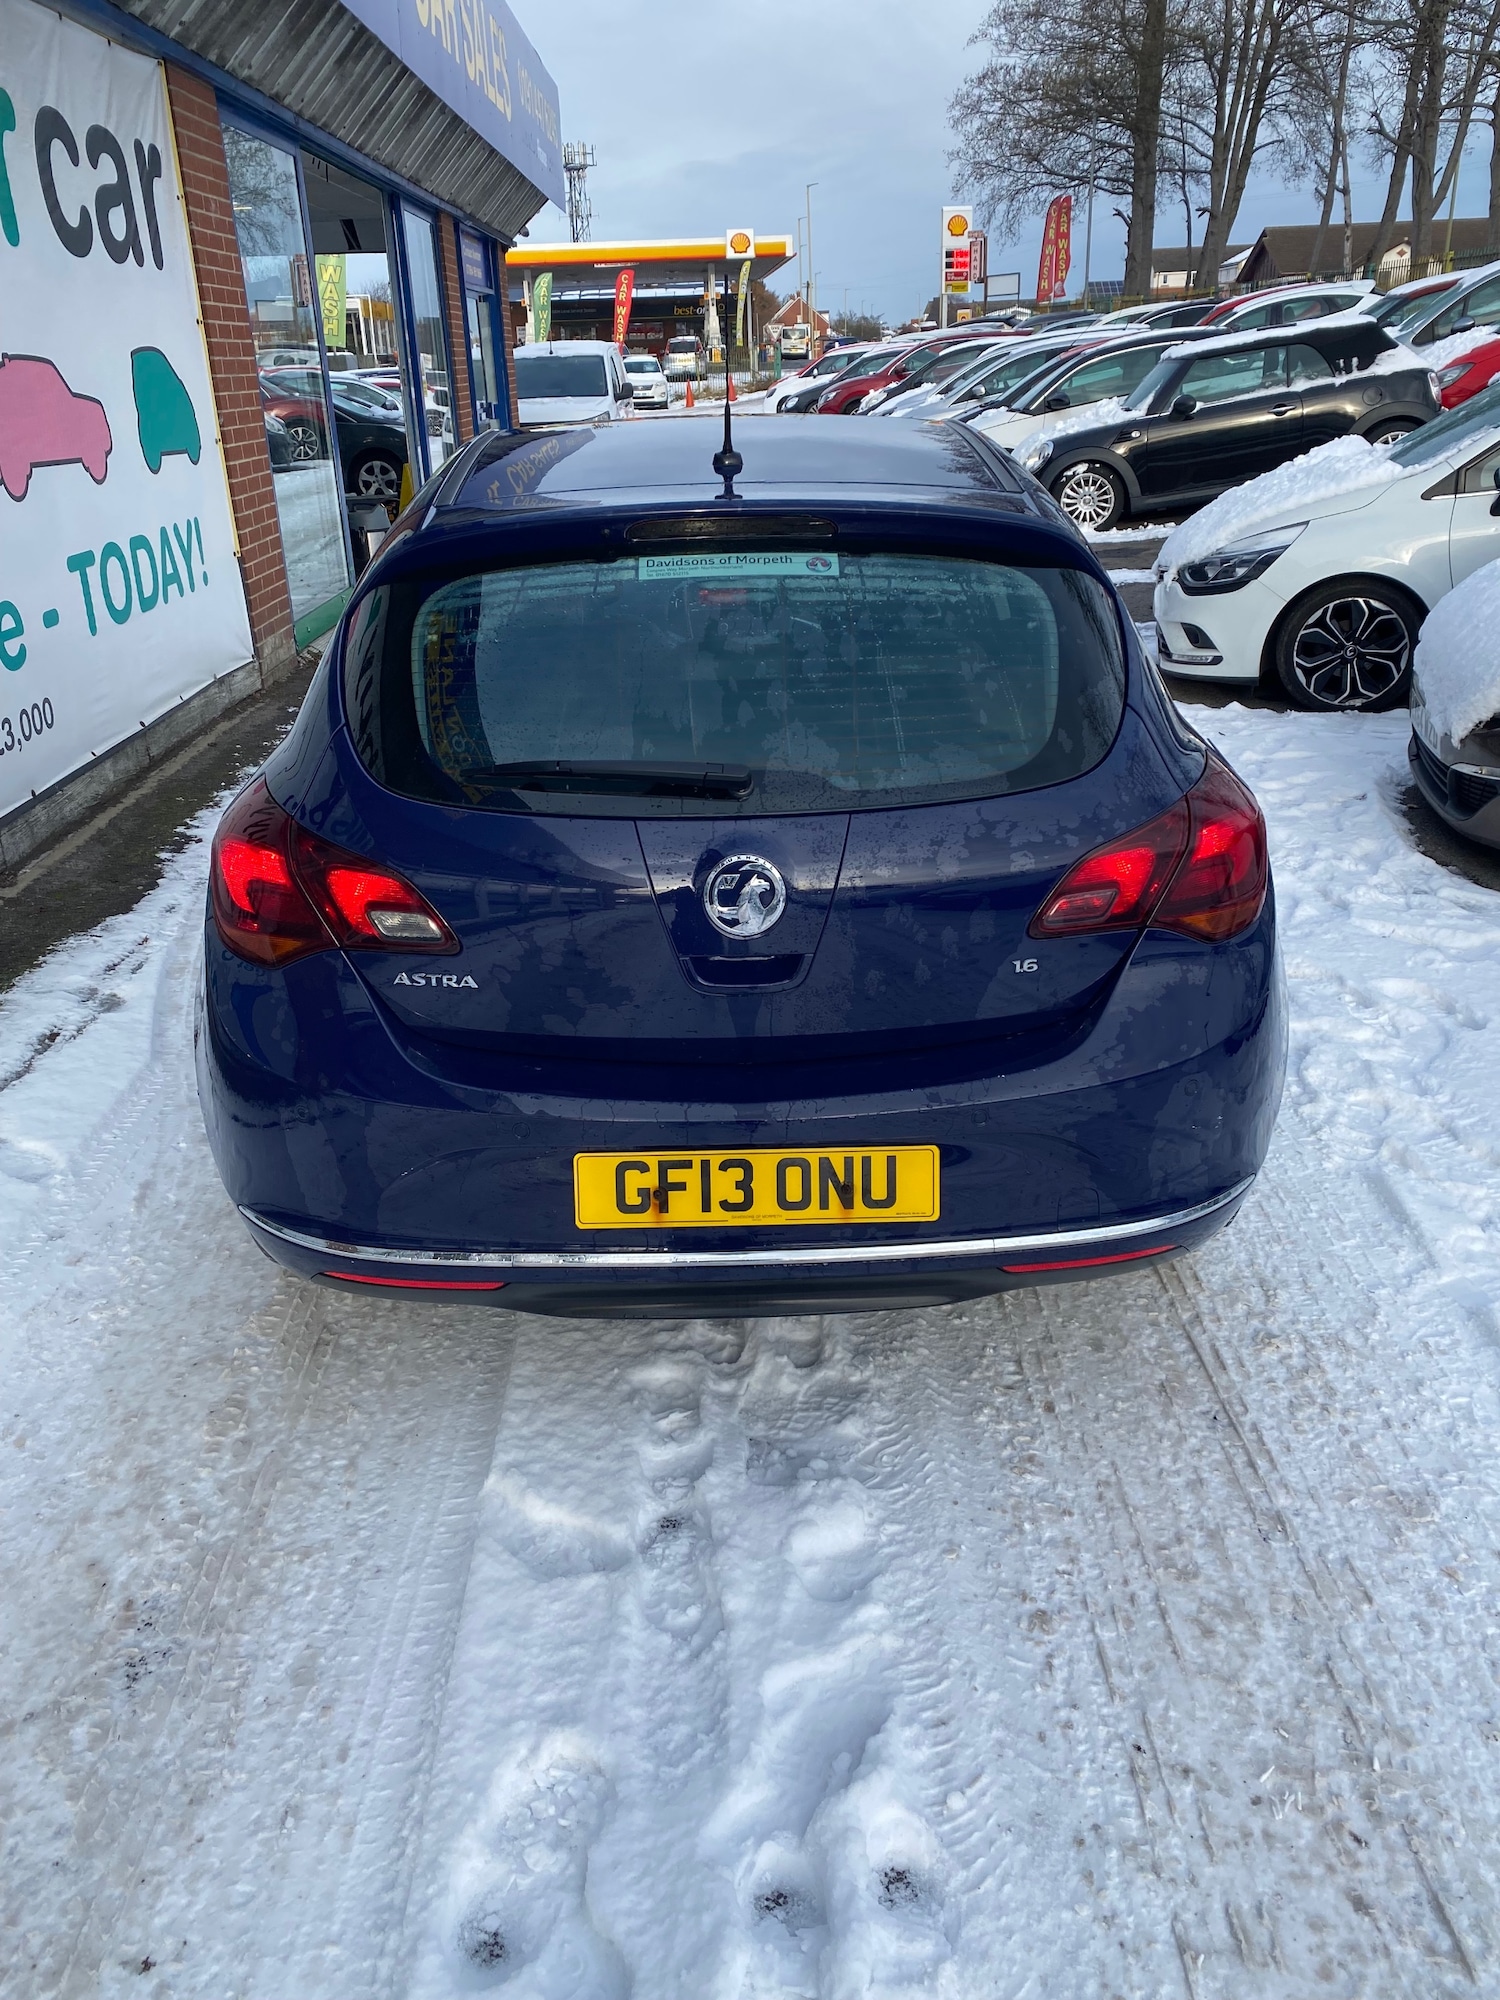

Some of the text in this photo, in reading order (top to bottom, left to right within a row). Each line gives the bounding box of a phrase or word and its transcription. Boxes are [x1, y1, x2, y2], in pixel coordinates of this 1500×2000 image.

[460, 0, 512, 123] SALES
[34, 105, 164, 271] car
[1040, 205, 1058, 290] CAR WASH
[1058, 202, 1068, 280] CAR WASH
[320, 263, 342, 337] WASH
[540, 278, 548, 305] CAR
[616, 274, 629, 341] CAR WASH
[66, 516, 209, 637] TODAY!
[646, 555, 793, 568] Davidsons of Morpeth
[393, 972, 479, 989] ASTRA
[1012, 958, 1039, 973] 1.6
[615, 1155, 897, 1214] GF13 ONU
